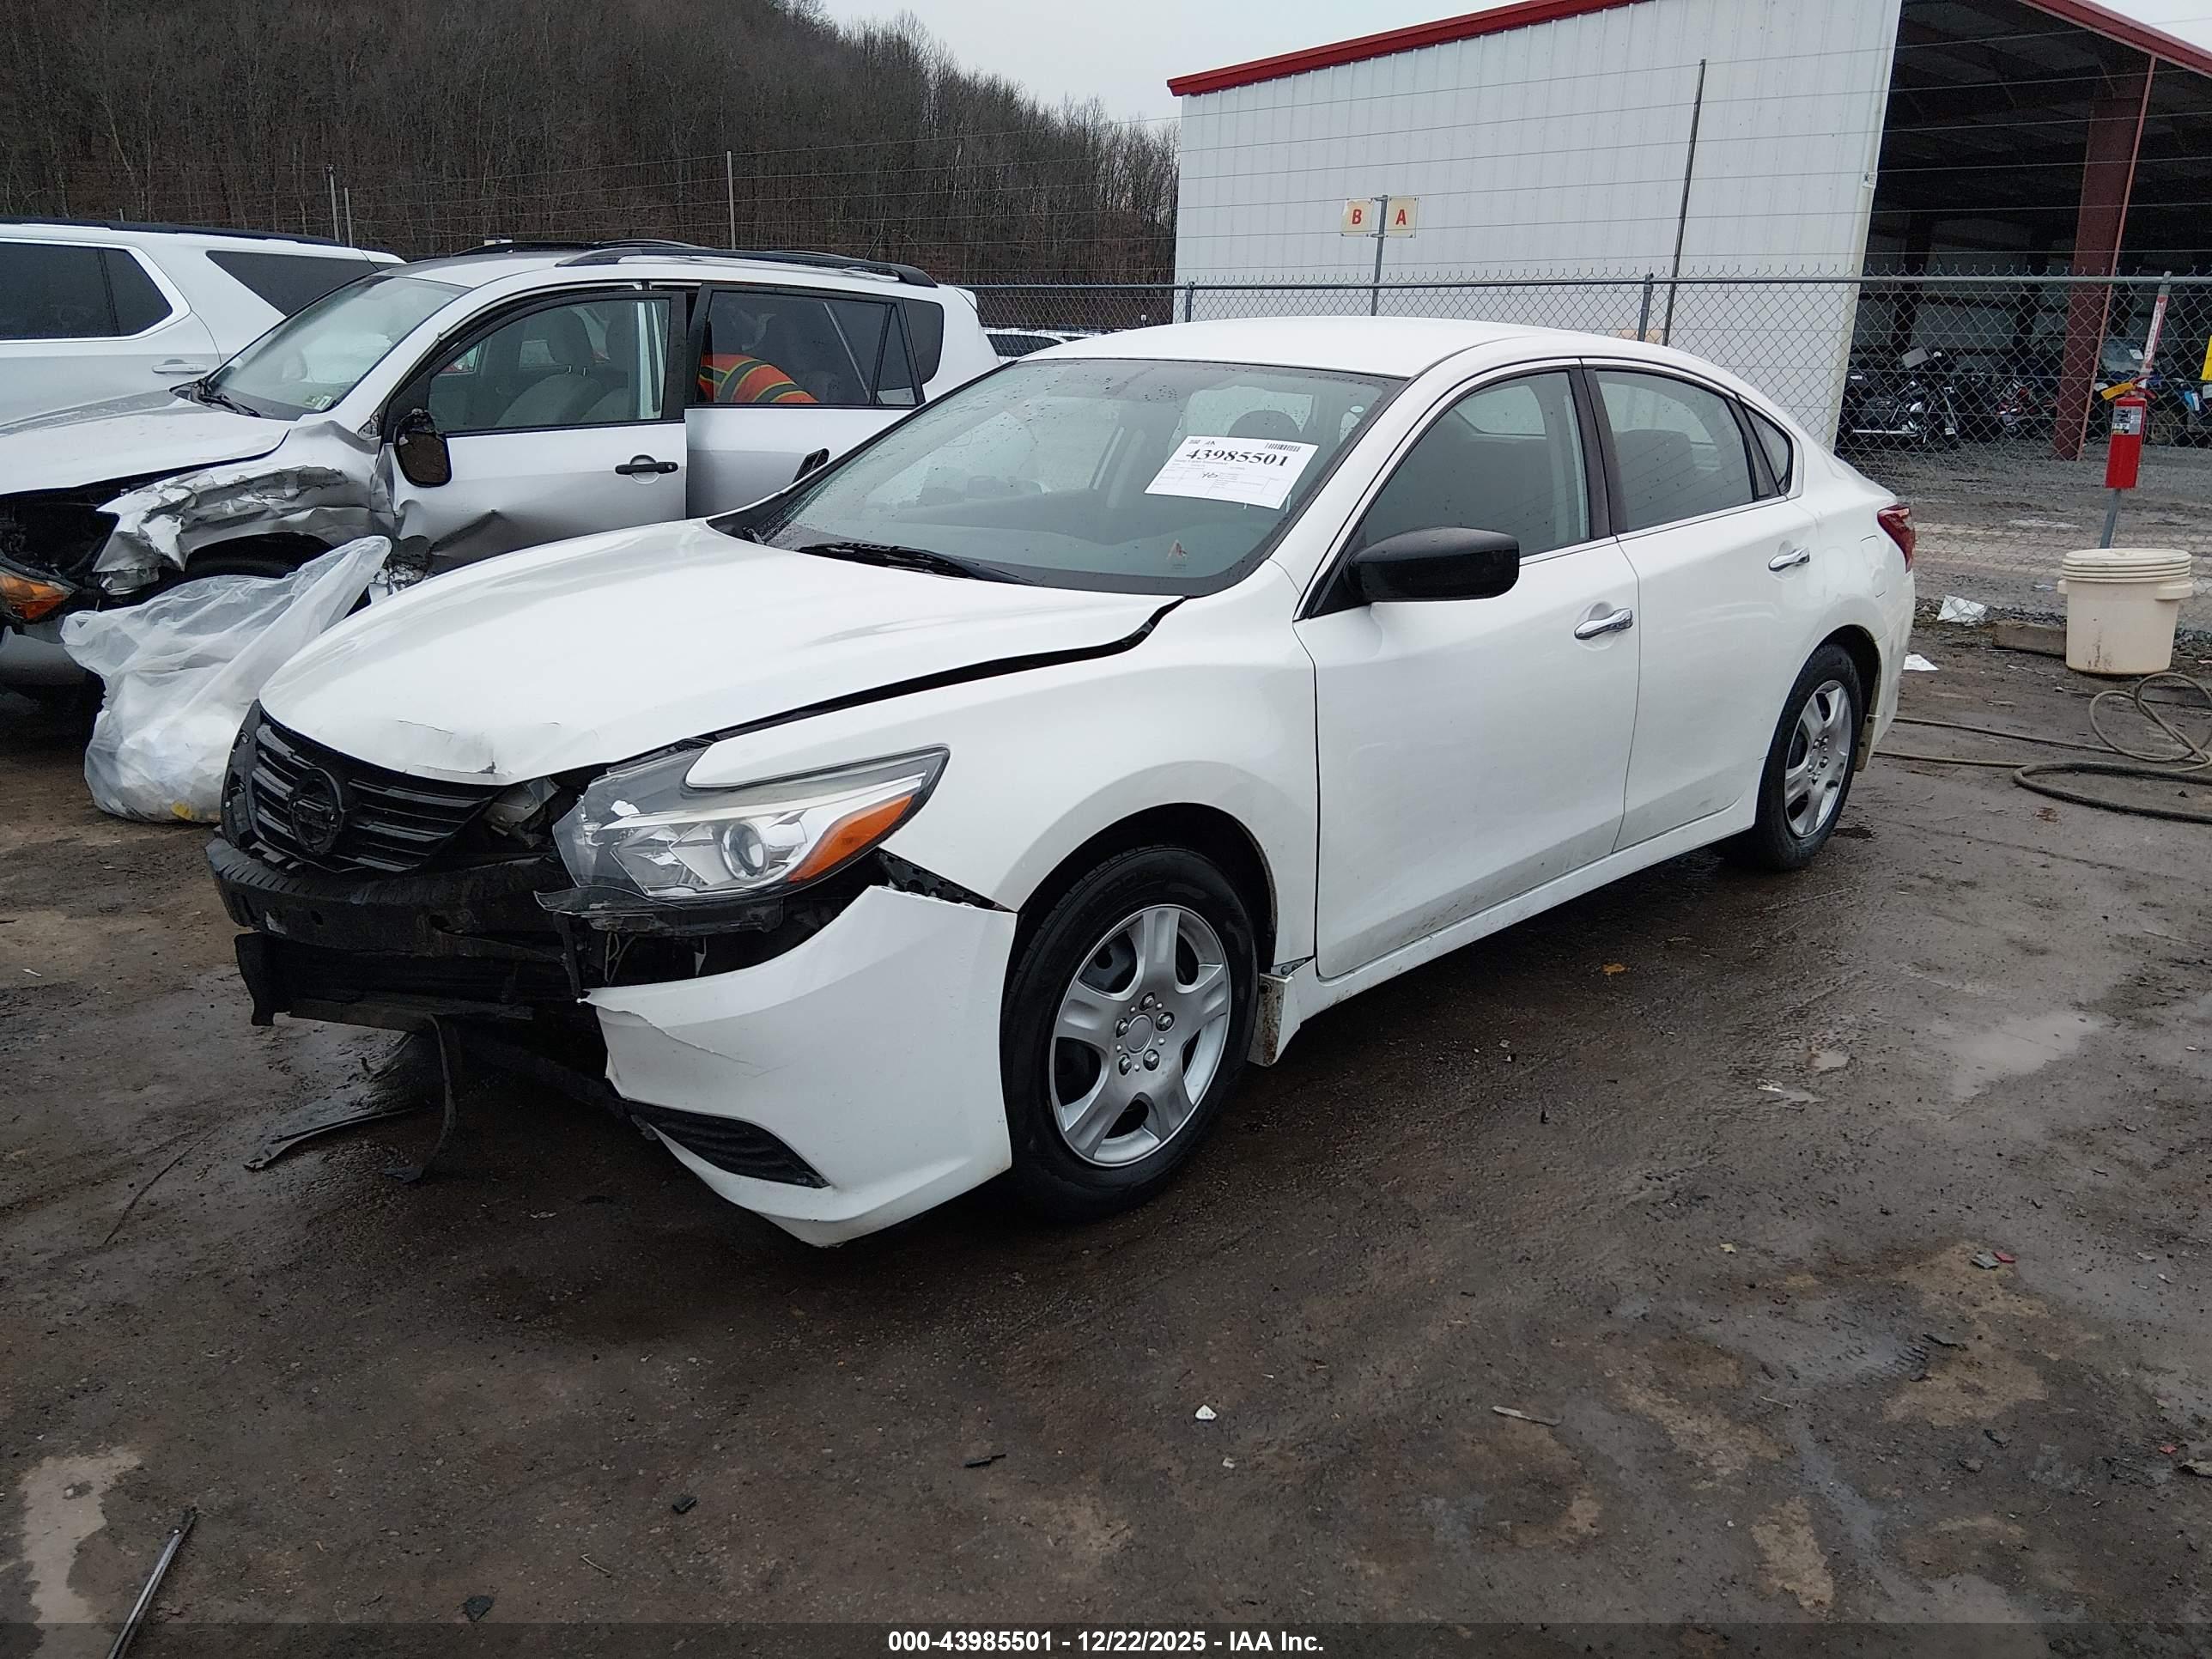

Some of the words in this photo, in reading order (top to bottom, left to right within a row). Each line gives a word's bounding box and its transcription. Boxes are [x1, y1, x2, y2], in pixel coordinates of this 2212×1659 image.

[1352, 209, 1362, 225] B
[1395, 209, 1407, 225] A
[1186, 448, 1288, 466] 43985501
